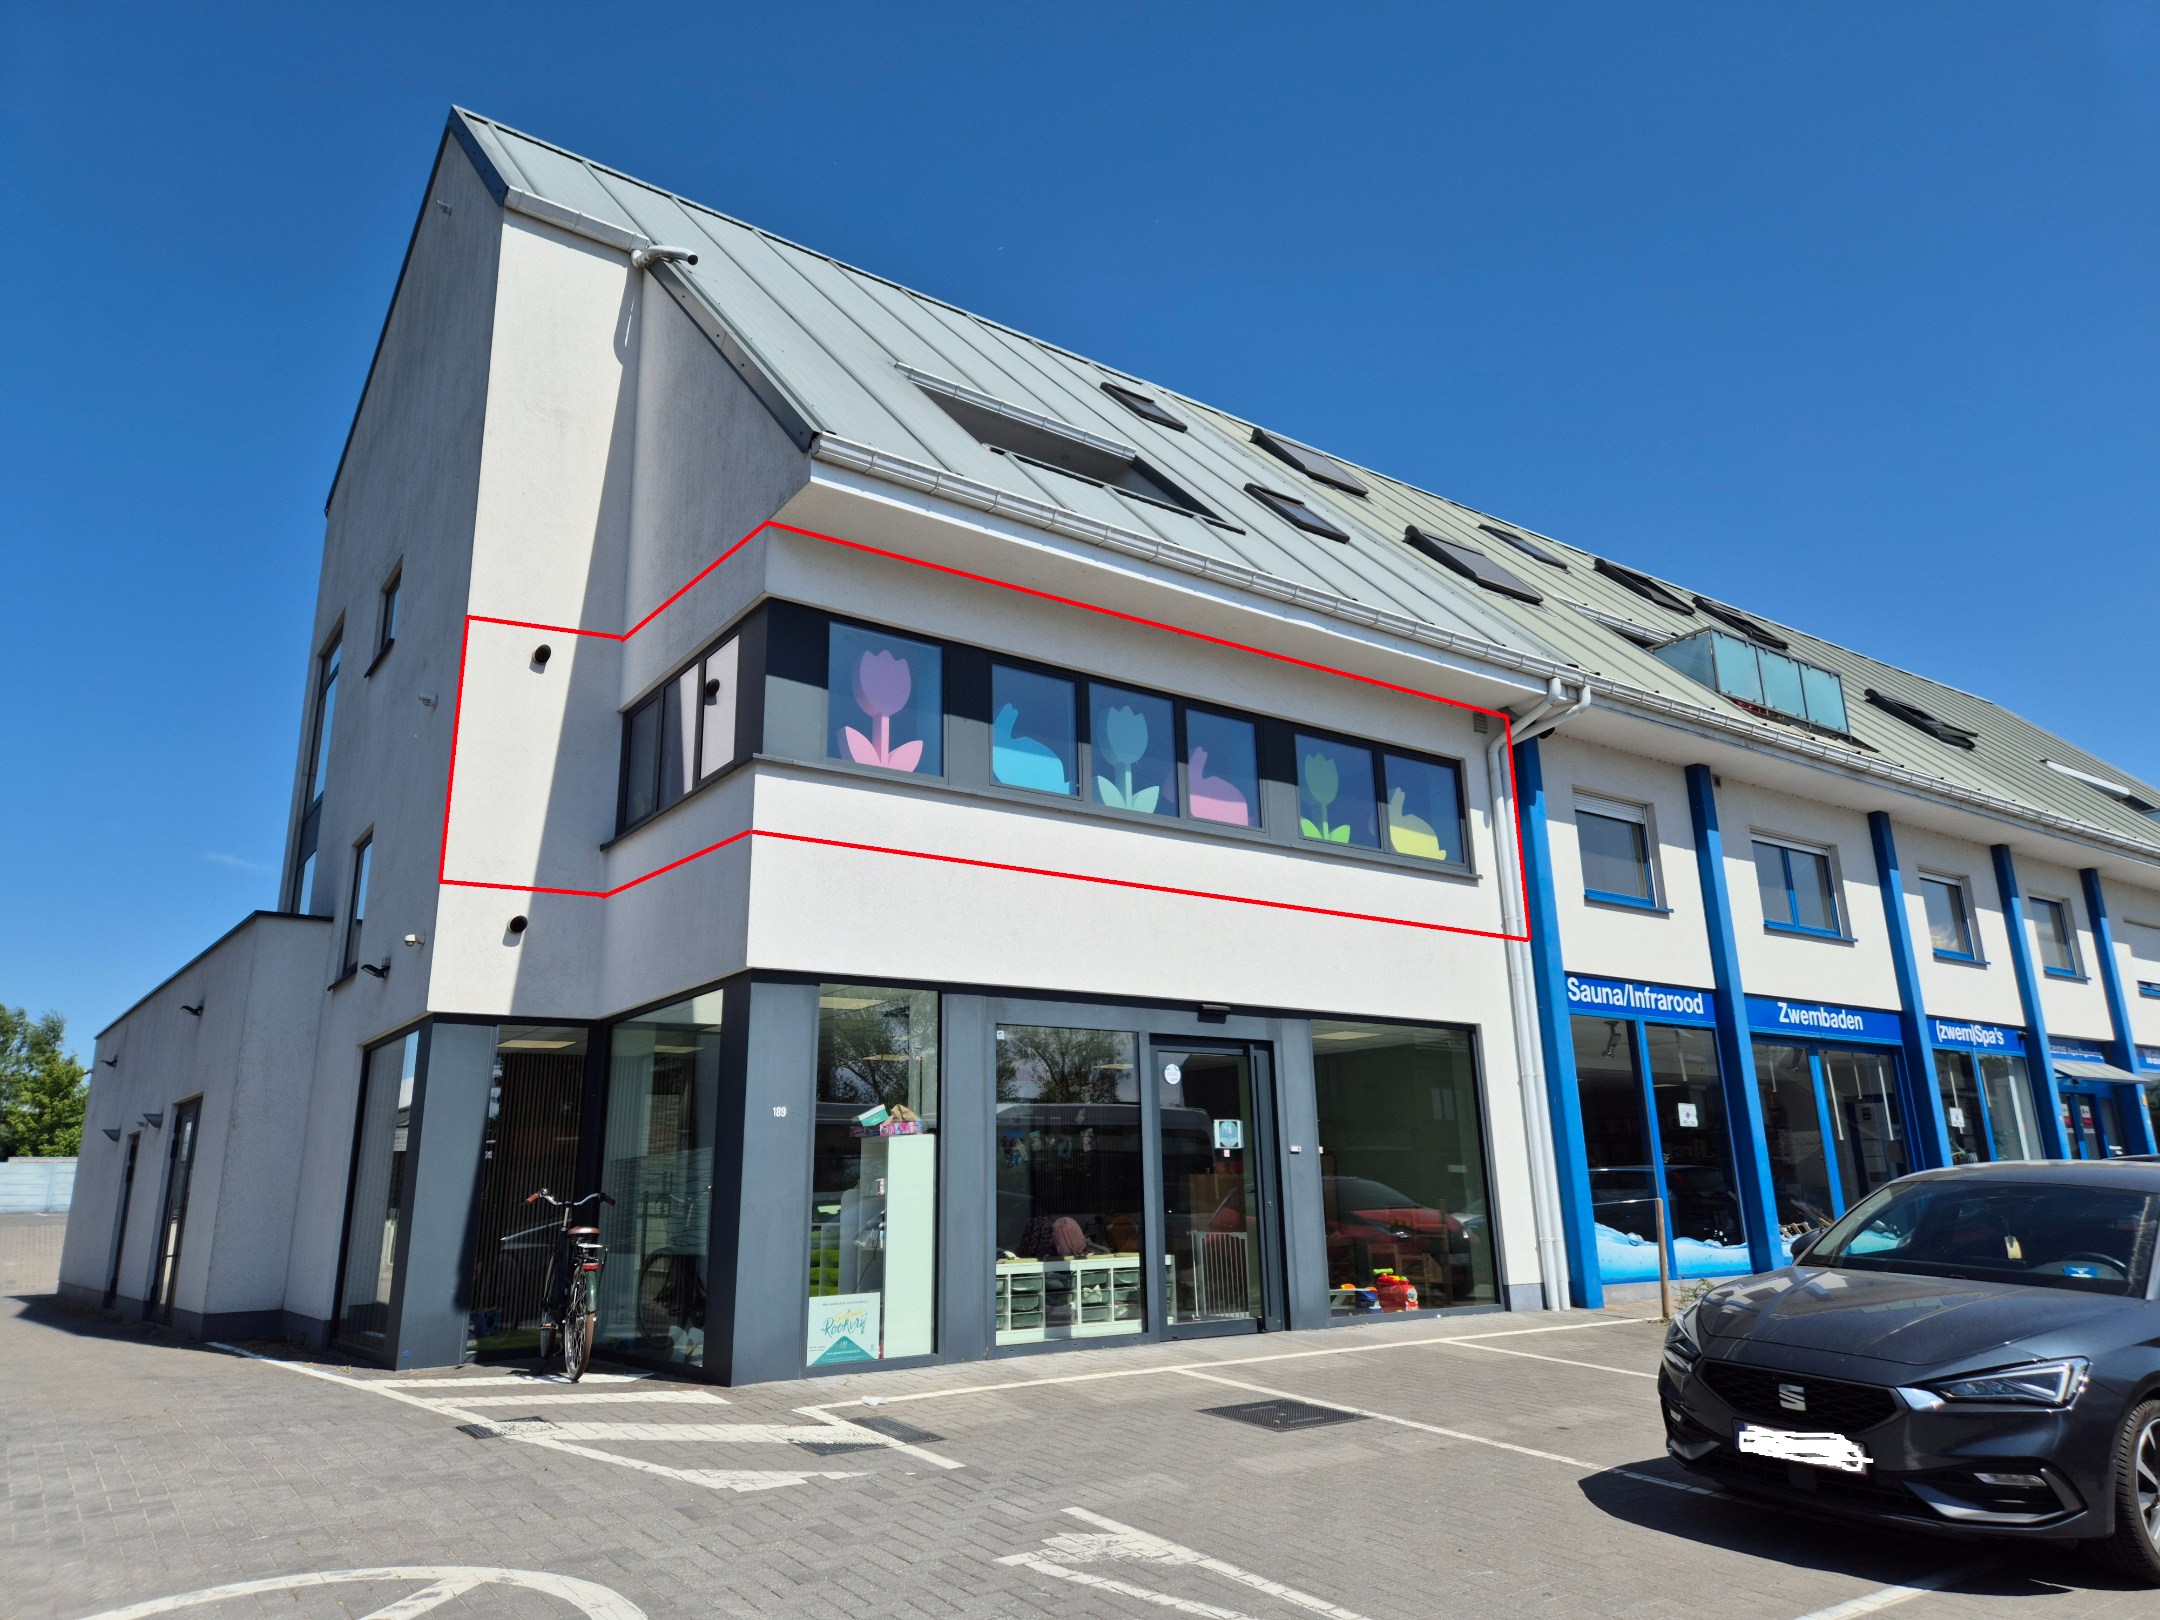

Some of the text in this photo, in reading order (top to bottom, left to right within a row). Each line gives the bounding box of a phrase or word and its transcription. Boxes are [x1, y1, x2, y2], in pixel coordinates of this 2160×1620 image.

[1567, 977, 1704, 1015] Sauna/Infrarood
[1777, 1001, 1864, 1031] Zwembaden
[1936, 1019, 2005, 1047] (zwem)Spa's
[772, 1106, 787, 1118] 189
